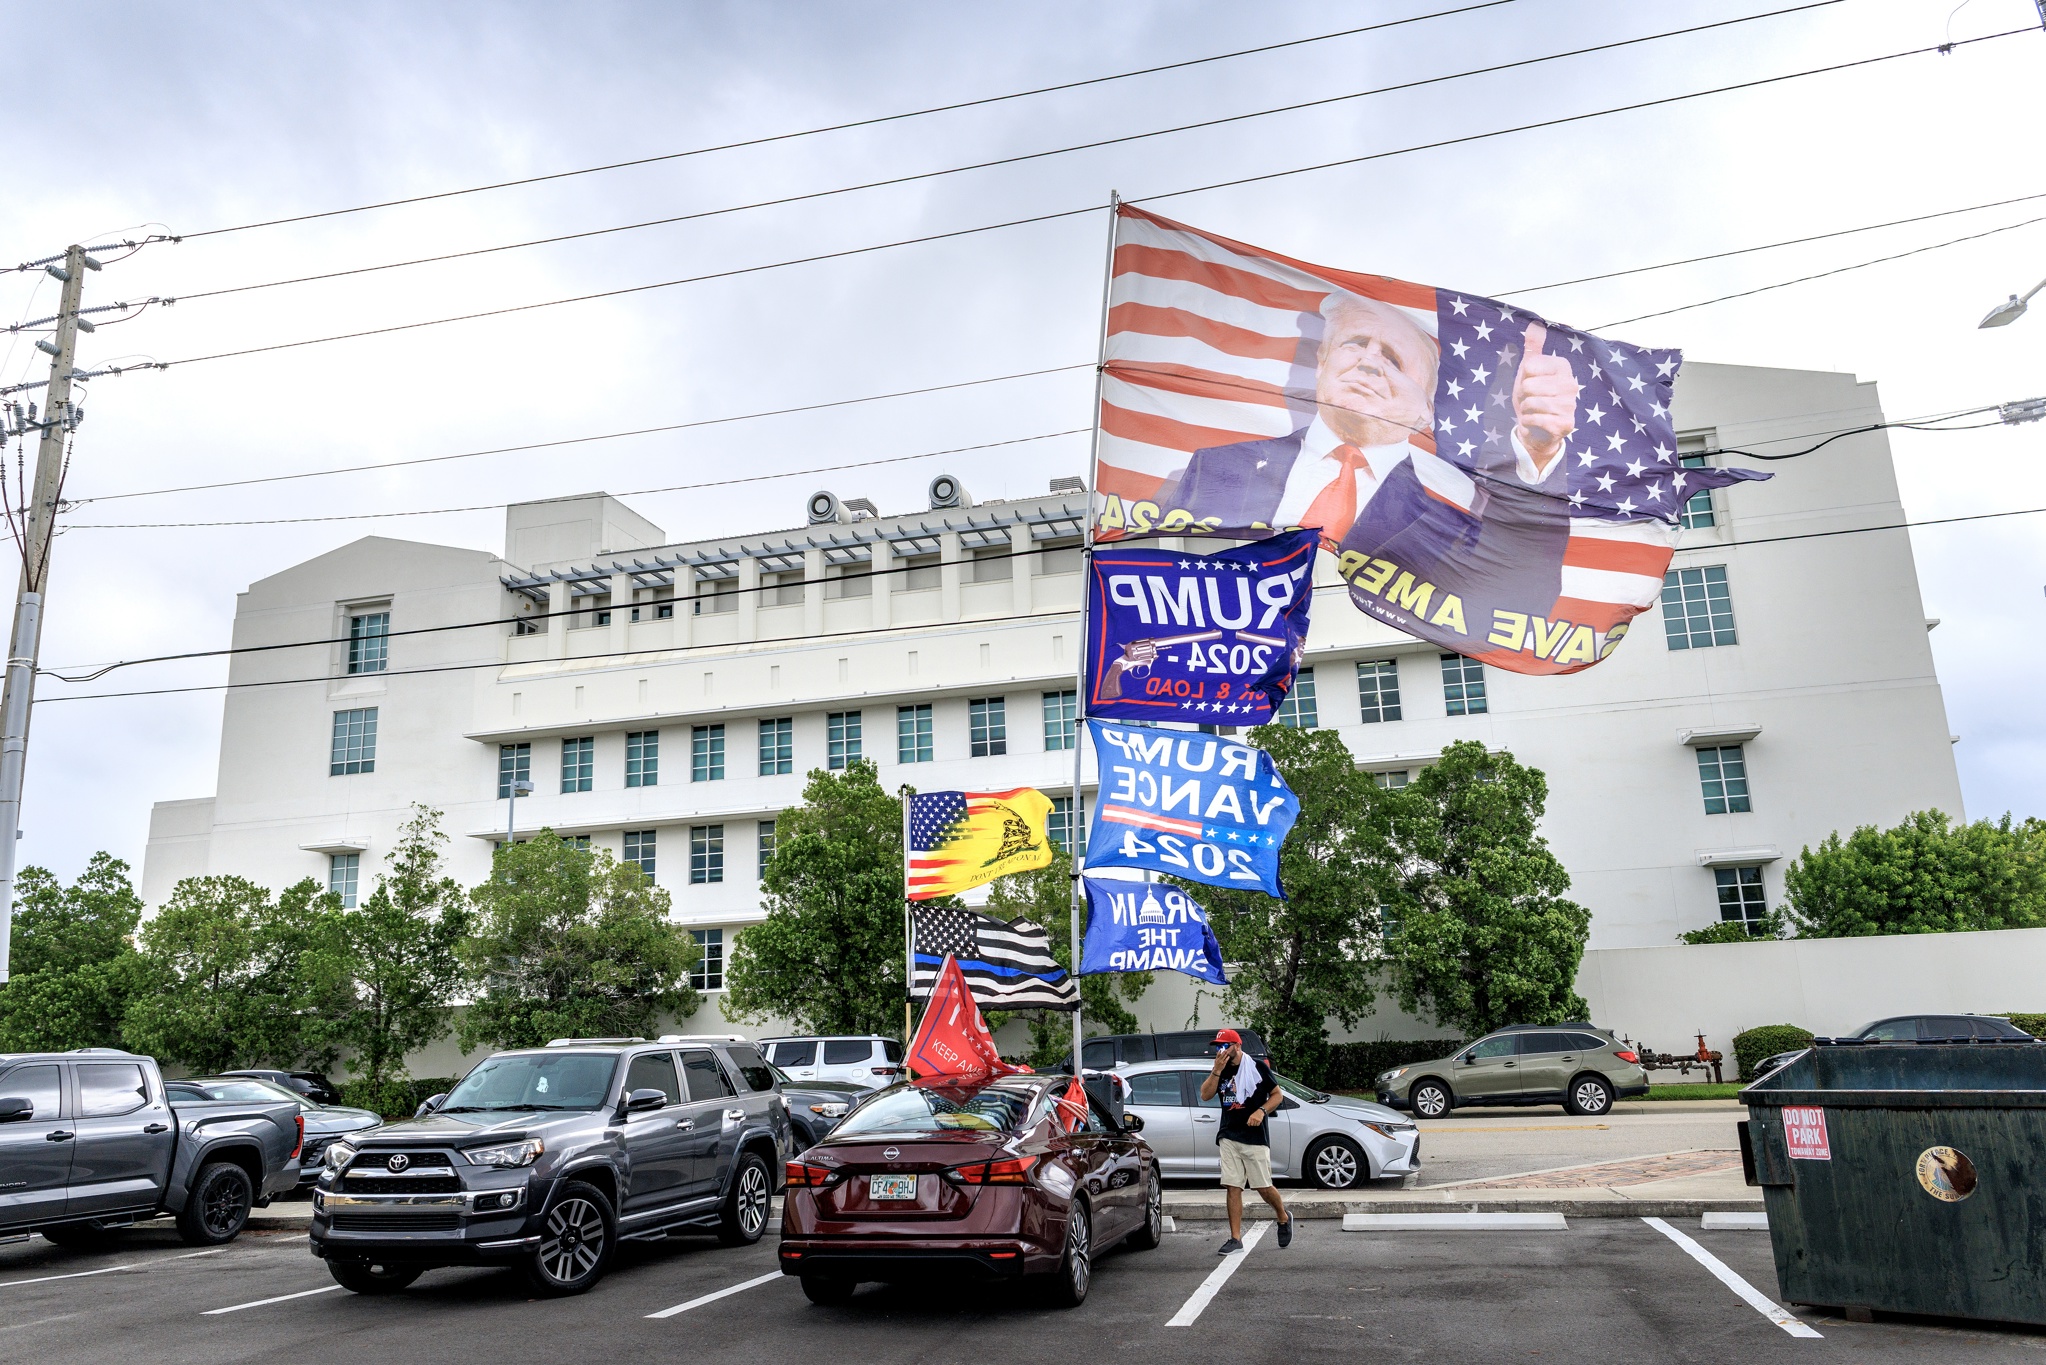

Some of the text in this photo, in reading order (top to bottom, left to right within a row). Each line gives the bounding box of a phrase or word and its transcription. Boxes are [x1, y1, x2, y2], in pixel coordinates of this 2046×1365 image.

[931, 1038, 984, 1074] KEEP AME
[1784, 1108, 1822, 1126] DO NOT
[1791, 1127, 1822, 1145] PARK
[871, 1181, 888, 1195] CF4
[1930, 1187, 1943, 1198] THE
